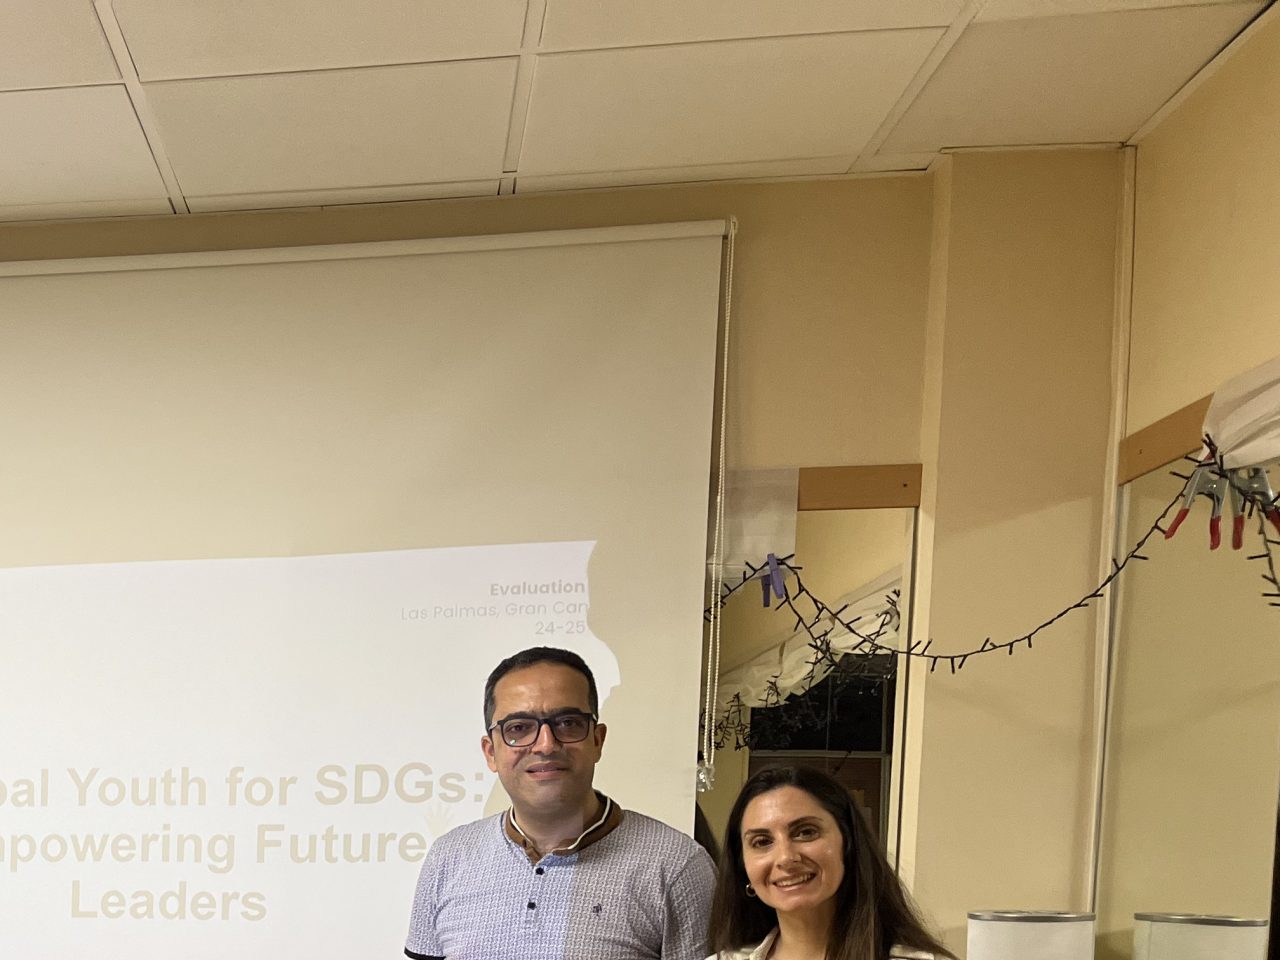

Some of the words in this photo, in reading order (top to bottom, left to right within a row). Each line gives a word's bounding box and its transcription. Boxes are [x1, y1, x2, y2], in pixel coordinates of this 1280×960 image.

[490, 579, 586, 596] Evaluation
[401, 606, 428, 621] Las
[433, 603, 500, 620] Palmas,
[505, 602, 547, 617] Gran
[535, 620, 586, 635] 24-25
[67, 766, 208, 808] Youth
[225, 765, 298, 807] for
[314, 761, 486, 806] SDGs:
[256, 822, 427, 864] Future
[71, 879, 268, 922] Leaders
